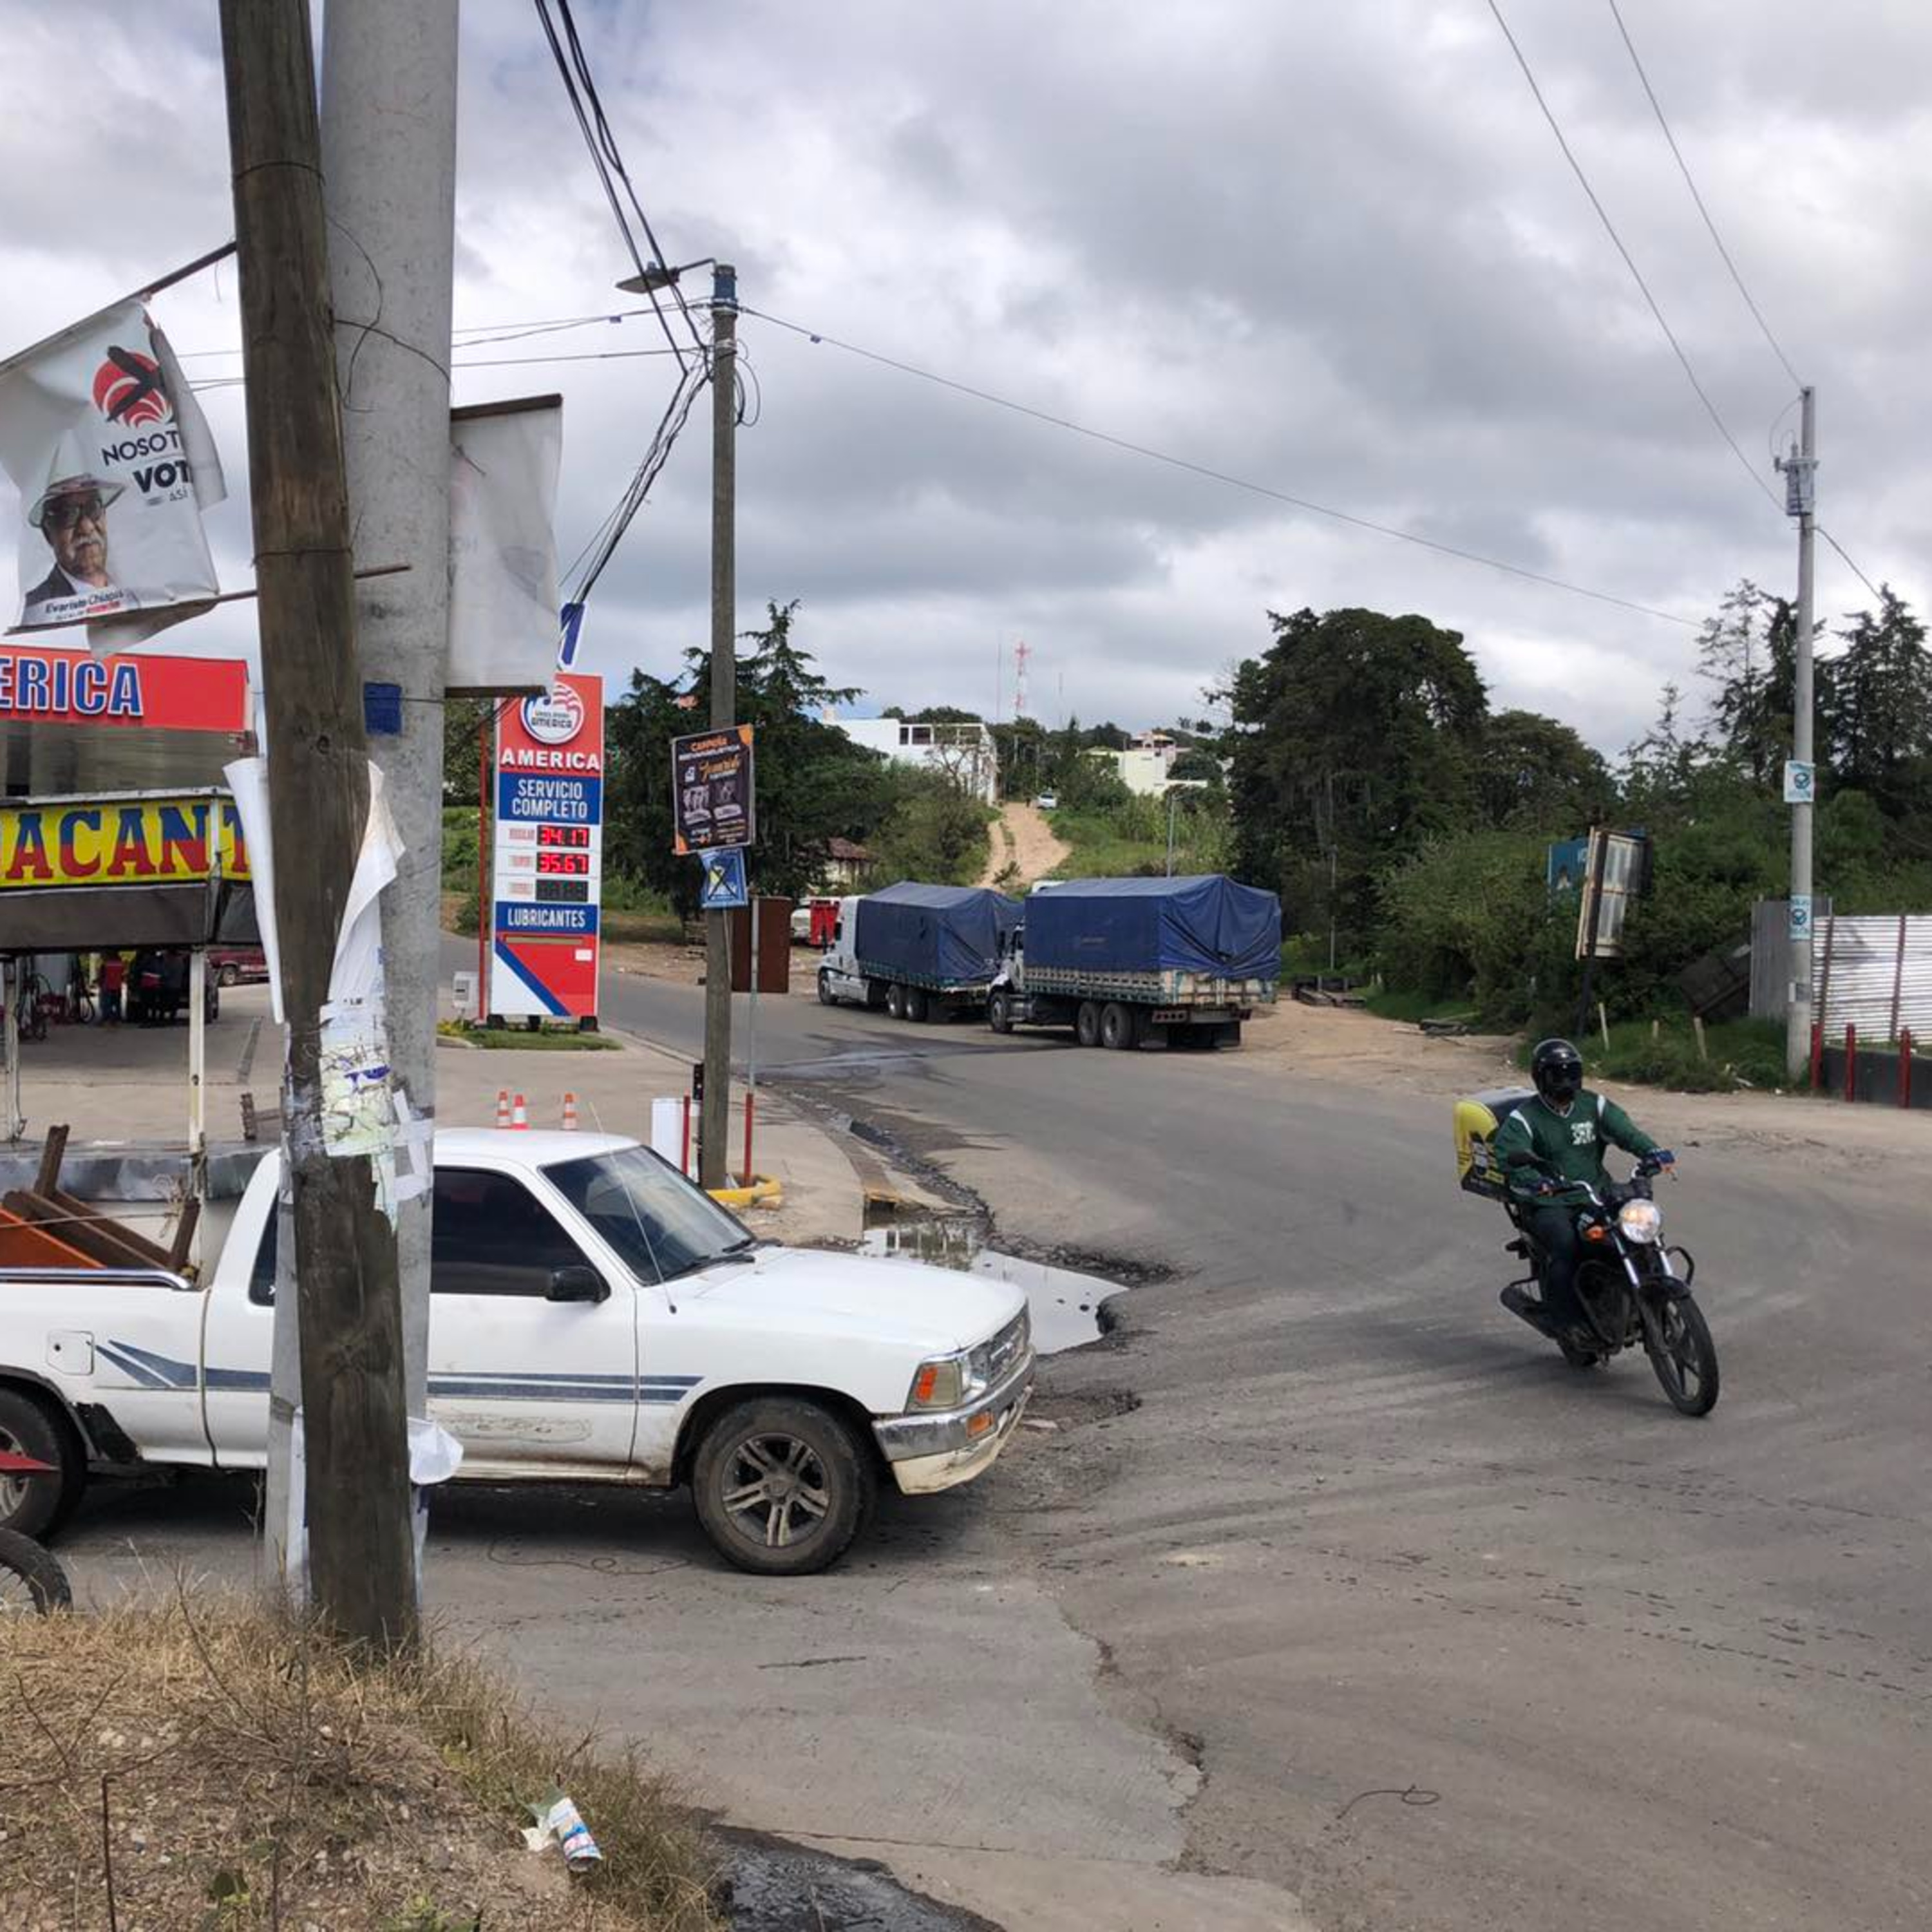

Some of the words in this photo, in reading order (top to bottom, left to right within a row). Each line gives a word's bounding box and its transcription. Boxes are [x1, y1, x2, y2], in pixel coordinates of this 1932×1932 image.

[101, 430, 178, 466] NOSOT
[132, 459, 190, 493] VOT
[500, 747, 600, 770] AMERICA
[518, 779, 583, 799] SERVICIO
[512, 798, 587, 818] COMPLETO
[507, 908, 586, 928] LUBRICANTES
